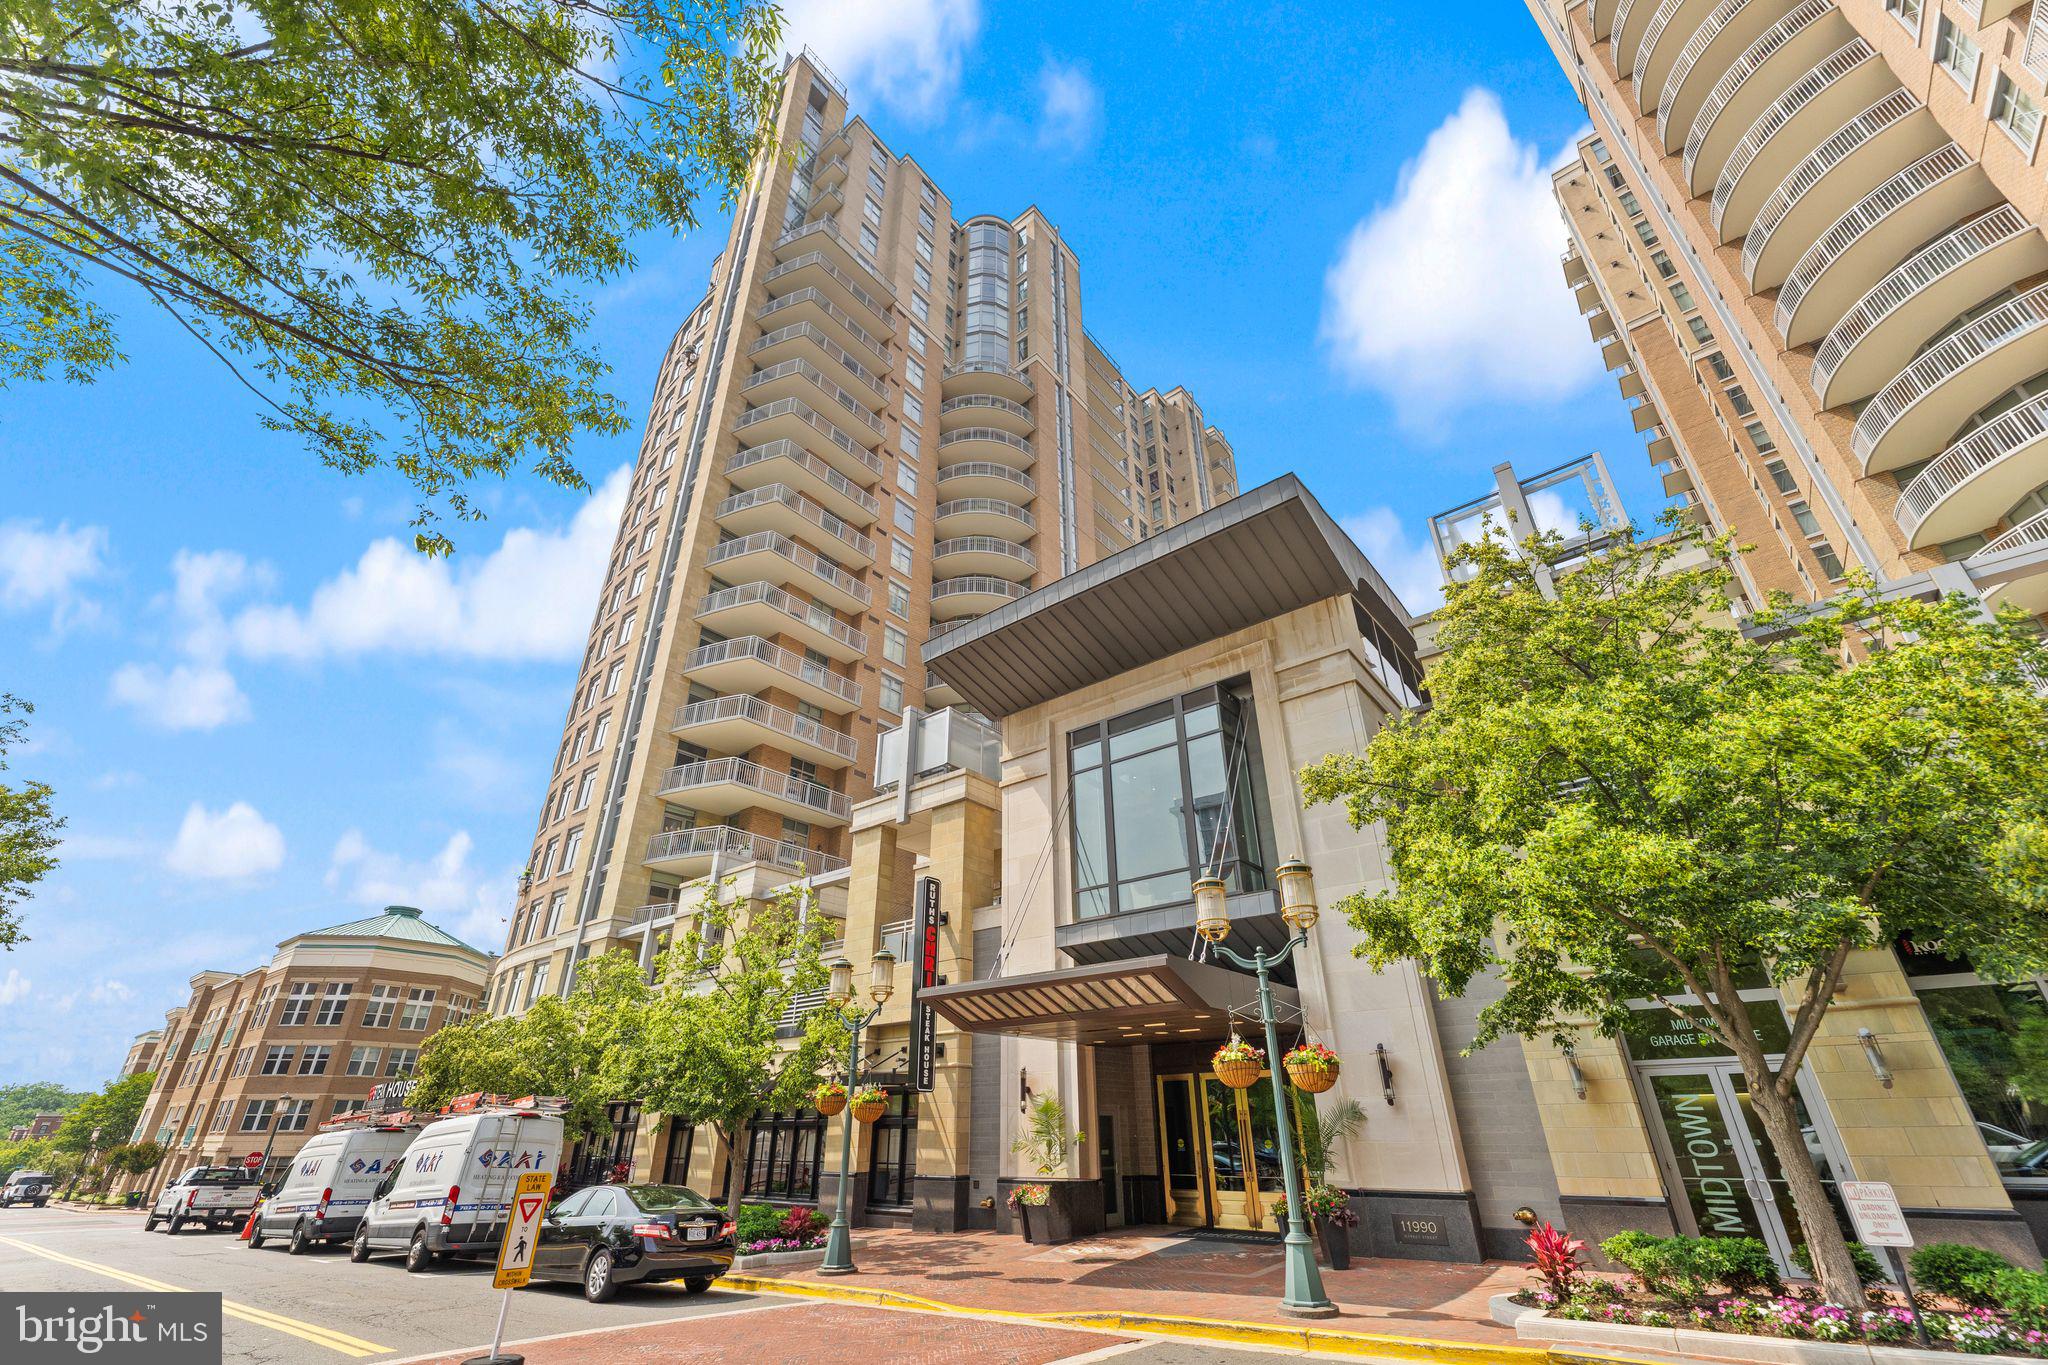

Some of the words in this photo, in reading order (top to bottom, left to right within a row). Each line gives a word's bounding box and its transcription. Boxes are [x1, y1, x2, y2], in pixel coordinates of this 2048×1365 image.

[924, 925, 937, 988] CHRI
[1650, 1033, 1697, 1047] GARAGE
[245, 1156, 263, 1164] STOP
[1671, 1094, 1746, 1233] MIDTOWN
[525, 1175, 547, 1183] STATE
[526, 1183, 541, 1191] LAW
[1860, 1188, 1891, 1198] PARKING
[1859, 1212, 1898, 1220] UNLOADING
[1401, 1220, 1437, 1233] 11990
